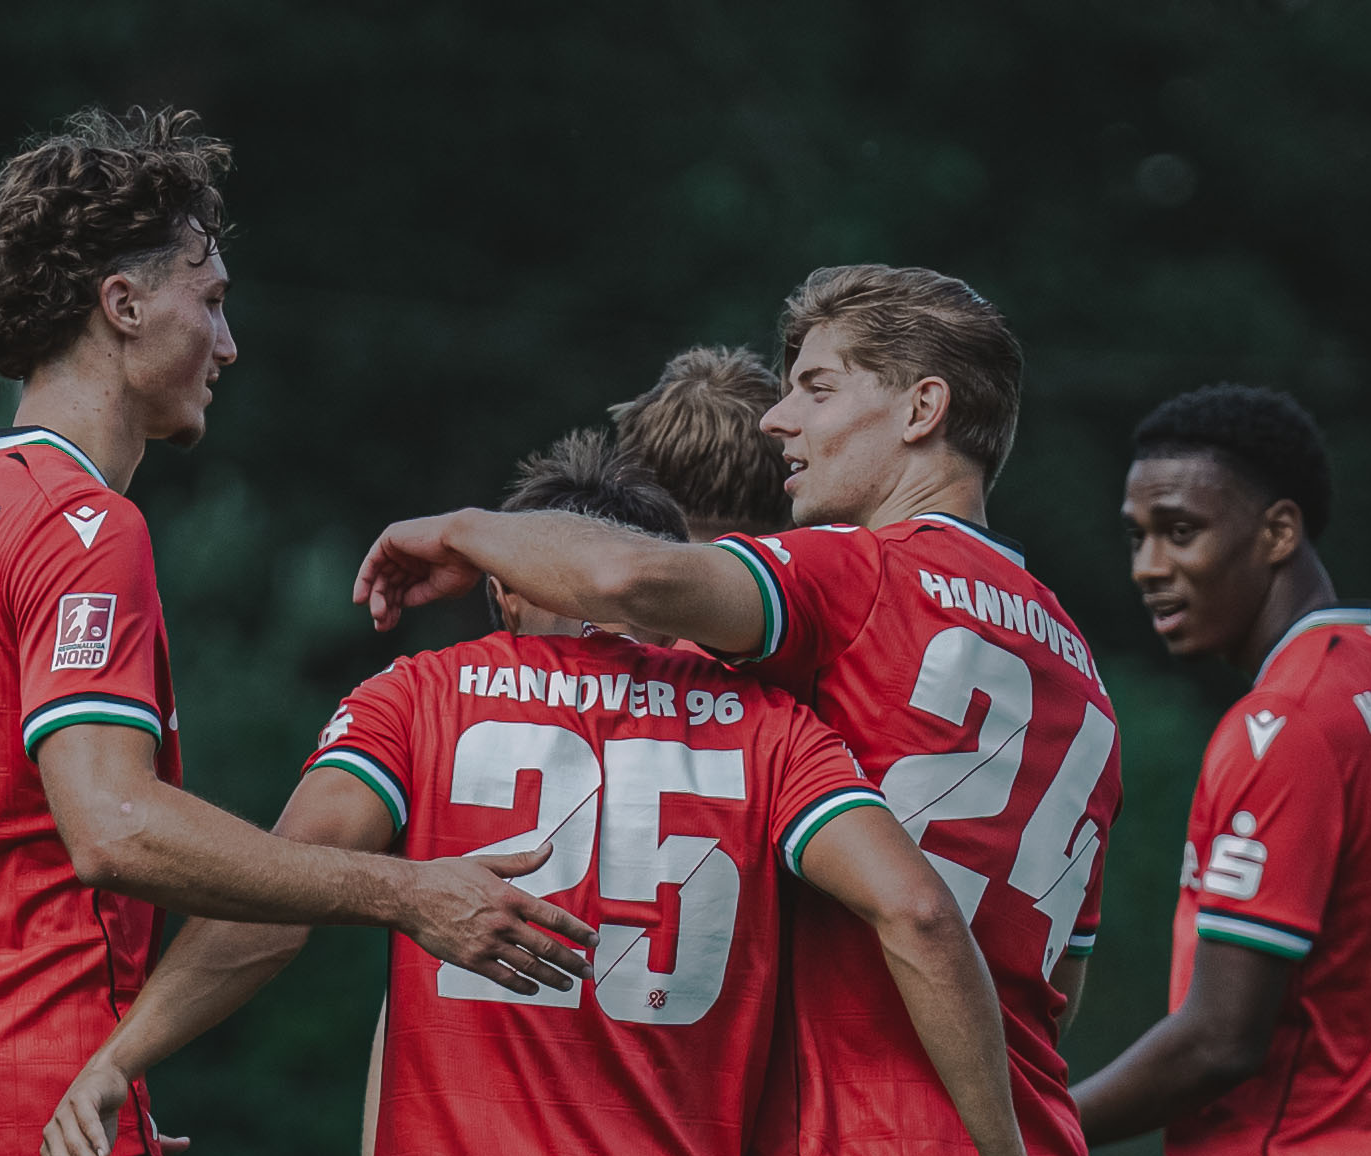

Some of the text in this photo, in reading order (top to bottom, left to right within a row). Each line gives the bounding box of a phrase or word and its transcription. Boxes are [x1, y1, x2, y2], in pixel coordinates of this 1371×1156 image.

[55, 650, 104, 667] NORD
[919, 569, 1092, 680] HANNOVER
[459, 665, 744, 725] HANNOVER 96
[880, 626, 1116, 982] 24
[437, 720, 746, 1025] 25
